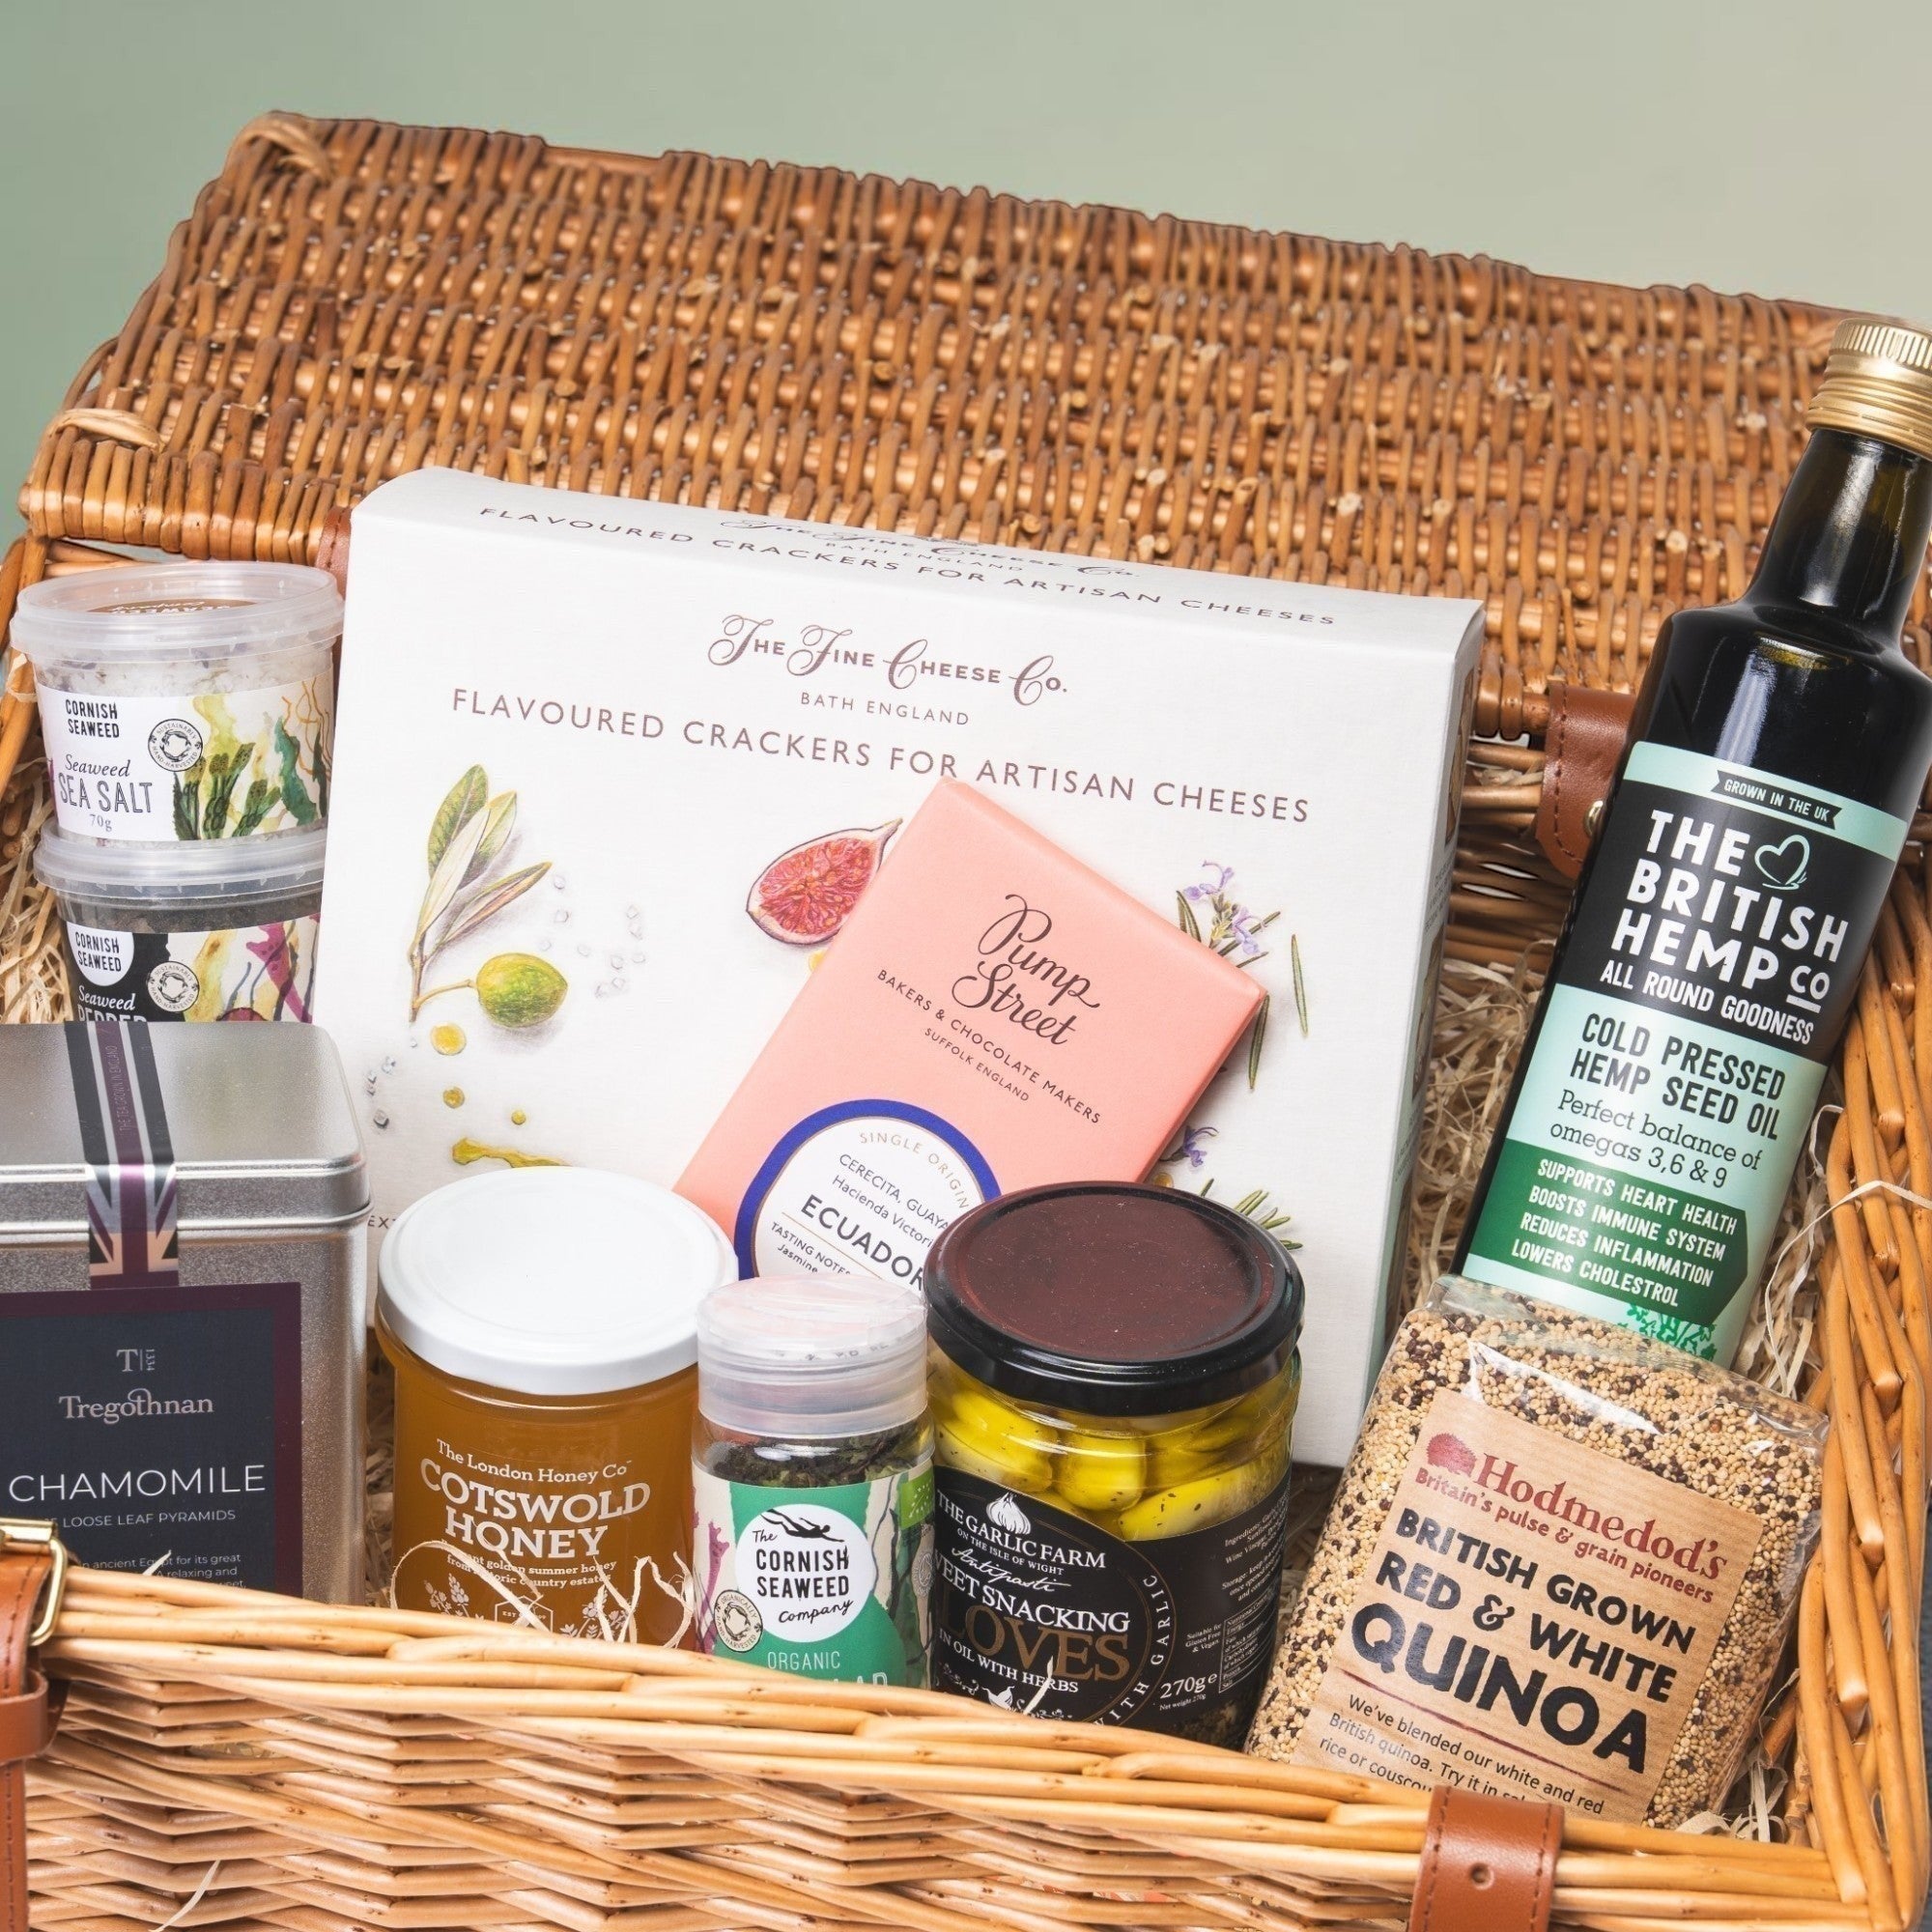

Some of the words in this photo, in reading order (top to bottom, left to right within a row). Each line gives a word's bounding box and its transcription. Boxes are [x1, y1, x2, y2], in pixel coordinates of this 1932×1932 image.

[480, 507, 694, 543] FLAVOURED
[712, 539, 899, 571] CRACKERS
[917, 566, 985, 582] FOR
[1003, 578, 1161, 604] ARTISAN
[1179, 599, 1335, 625] CHEESES
[825, 542, 888, 554] BATH
[903, 552, 1023, 572] ENGLAND
[65, 698, 118, 720] CORNISH
[68, 718, 120, 738] SEAWEED
[800, 692, 854, 711] BATH
[867, 700, 969, 725] ENGLAND
[65, 753, 130, 778] Seaweed
[452, 688, 665, 739] FLAVOURED
[683, 721, 870, 767] CRACKERS
[889, 748, 957, 778] FOR
[976, 759, 1134, 801] ARTISAN
[1152, 782, 1309, 823] CHEESES
[58, 772, 91, 810] SEA
[97, 781, 153, 813] SALT
[1723, 779, 1766, 802] GROWN
[1770, 791, 1784, 807] IN
[1788, 797, 1811, 815] THE
[1813, 805, 1831, 822] UK
[89, 813, 112, 832] 70g
[1646, 810, 1751, 876] THE
[1626, 858, 1849, 962] BRITISH
[75, 931, 120, 953] CORNISH
[77, 951, 122, 972] SEAWEED
[978, 894, 1100, 1009] Pump
[1610, 908, 1779, 990] HEMP
[1790, 965, 1831, 1000] CO
[78, 984, 136, 1011] Seaweed
[952, 960, 1077, 1045] Street
[1600, 959, 1634, 990] ALL
[1642, 971, 1715, 1012] ROUND
[1720, 995, 1814, 1045] GOODNESS
[877, 969, 931, 1011] BAKERS
[934, 1009, 945, 1022] &
[950, 1018, 1040, 1084] CHOCOLATE
[1042, 1080, 1100, 1124] MAKERS
[923, 1027, 975, 1065] SUFFOLK
[976, 1062, 1030, 1102] ENGLAND
[1582, 1012, 1651, 1058] COLD
[1661, 1036, 1786, 1101] PRESSED
[1570, 1048, 1651, 1095] HEMP
[1662, 1076, 1740, 1124] SEED
[1747, 1102, 1781, 1141] OIL
[1549, 1122, 1642, 1162] omegas
[1648, 1147, 1686, 1175] 3,6
[1690, 1159, 1710, 1184] &
[1713, 1167, 1728, 1189] 9
[1557, 1089, 1636, 1131] Perfect
[1639, 1113, 1738, 1163] balance
[1741, 1150, 1764, 1171] of
[838, 1153, 901, 1204] CERECITA,
[859, 1131, 923, 1153] SINGLE
[927, 1152, 970, 1209] ORIGIN
[832, 1174, 890, 1220] Hacienda
[1537, 1158, 1616, 1197] SUPPORTS
[1620, 1183, 1679, 1216] HEART
[1681, 1204, 1738, 1236] HEALTH
[771, 1221, 814, 1255] TASTING
[1520, 1211, 1589, 1248] REDUCES
[1593, 1236, 1715, 1287] INFLAMMATION
[1528, 1185, 1588, 1218] BOOSTS
[1591, 1205, 1662, 1242] IMMUNE
[1665, 1228, 1727, 1262] SYSTEM
[778, 1243, 818, 1273] Jasmine
[1511, 1238, 1576, 1273] LOWERS
[1578, 1260, 1679, 1308] CHOLESTROL
[116, 1349, 138, 1372] T
[58, 1387, 214, 1425] Tregothnan
[9, 1464, 266, 1502] CHAMOMILE
[437, 1437, 464, 1463] The
[467, 1453, 533, 1481] London
[537, 1466, 599, 1484] Honey
[420, 1458, 651, 1523] COTSWOLD
[1473, 1452, 1728, 1580] Hodmedod's
[63, 1515, 112, 1528] LOOSE
[118, 1513, 154, 1525] LEAF
[158, 1509, 236, 1523] PYRAMIDS
[445, 1505, 609, 1558] HONEY
[753, 1529, 778, 1544] The
[937, 1489, 964, 1525] THE
[965, 1515, 1037, 1556] GARLIC
[1040, 1544, 1106, 1569] FARM
[1415, 1466, 1492, 1513] Britain's
[1494, 1505, 1550, 1537] pulse
[1554, 1526, 1575, 1545] &
[1575, 1538, 1630, 1570] grain
[1630, 1560, 1715, 1605] pioneers
[93, 1559, 136, 1570] ancient
[176, 1555, 191, 1565] for
[194, 1555, 208, 1564] its
[210, 1553, 241, 1566] great
[166, 1568, 213, 1578] relaxing
[214, 1566, 238, 1577] and
[528, 1566, 579, 1576] summer
[755, 1546, 849, 1572] CORNISH
[952, 1548, 1072, 1592] Antipasti
[957, 1527, 969, 1540] ON
[970, 1535, 987, 1550] THE
[989, 1546, 1010, 1561] ISLE
[1012, 1555, 1025, 1565] OF
[1028, 1561, 1065, 1576] WIGHT
[756, 1576, 850, 1599] SEAWEED
[1395, 1507, 1539, 1591] BRITISH
[1546, 1573, 1696, 1655] GROWN
[982, 1584, 1130, 1633] SNACKING
[1143, 1575, 1171, 1665] GARLIC
[1375, 1550, 1462, 1610] RED
[1472, 1594, 1516, 1632] &
[1529, 1612, 1678, 1704] WHITE
[767, 1651, 840, 1671] ORGANIC
[939, 1628, 952, 1644] IN
[952, 1641, 975, 1662] OIL
[977, 1654, 1017, 1681] WITH
[1022, 1672, 1079, 1693] HERBS
[1351, 1602, 1648, 1775] QUINOA
[1319, 1736, 1347, 1757] rice
[1349, 1753, 1368, 1768] or
[1328, 1713, 1376, 1746] British
[1378, 1739, 1435, 1774] quinoa.
[1440, 1762, 1465, 1787] Try
[1467, 1775, 1480, 1790] it
[1483, 1781, 1498, 1796] in
[1349, 1694, 1395, 1726] We've
[1397, 1717, 1463, 1756] blended
[1463, 1748, 1493, 1769] our
[1495, 1760, 1541, 1790] white
[1543, 1781, 1579, 1804] and
[1577, 1795, 1605, 1815] red
